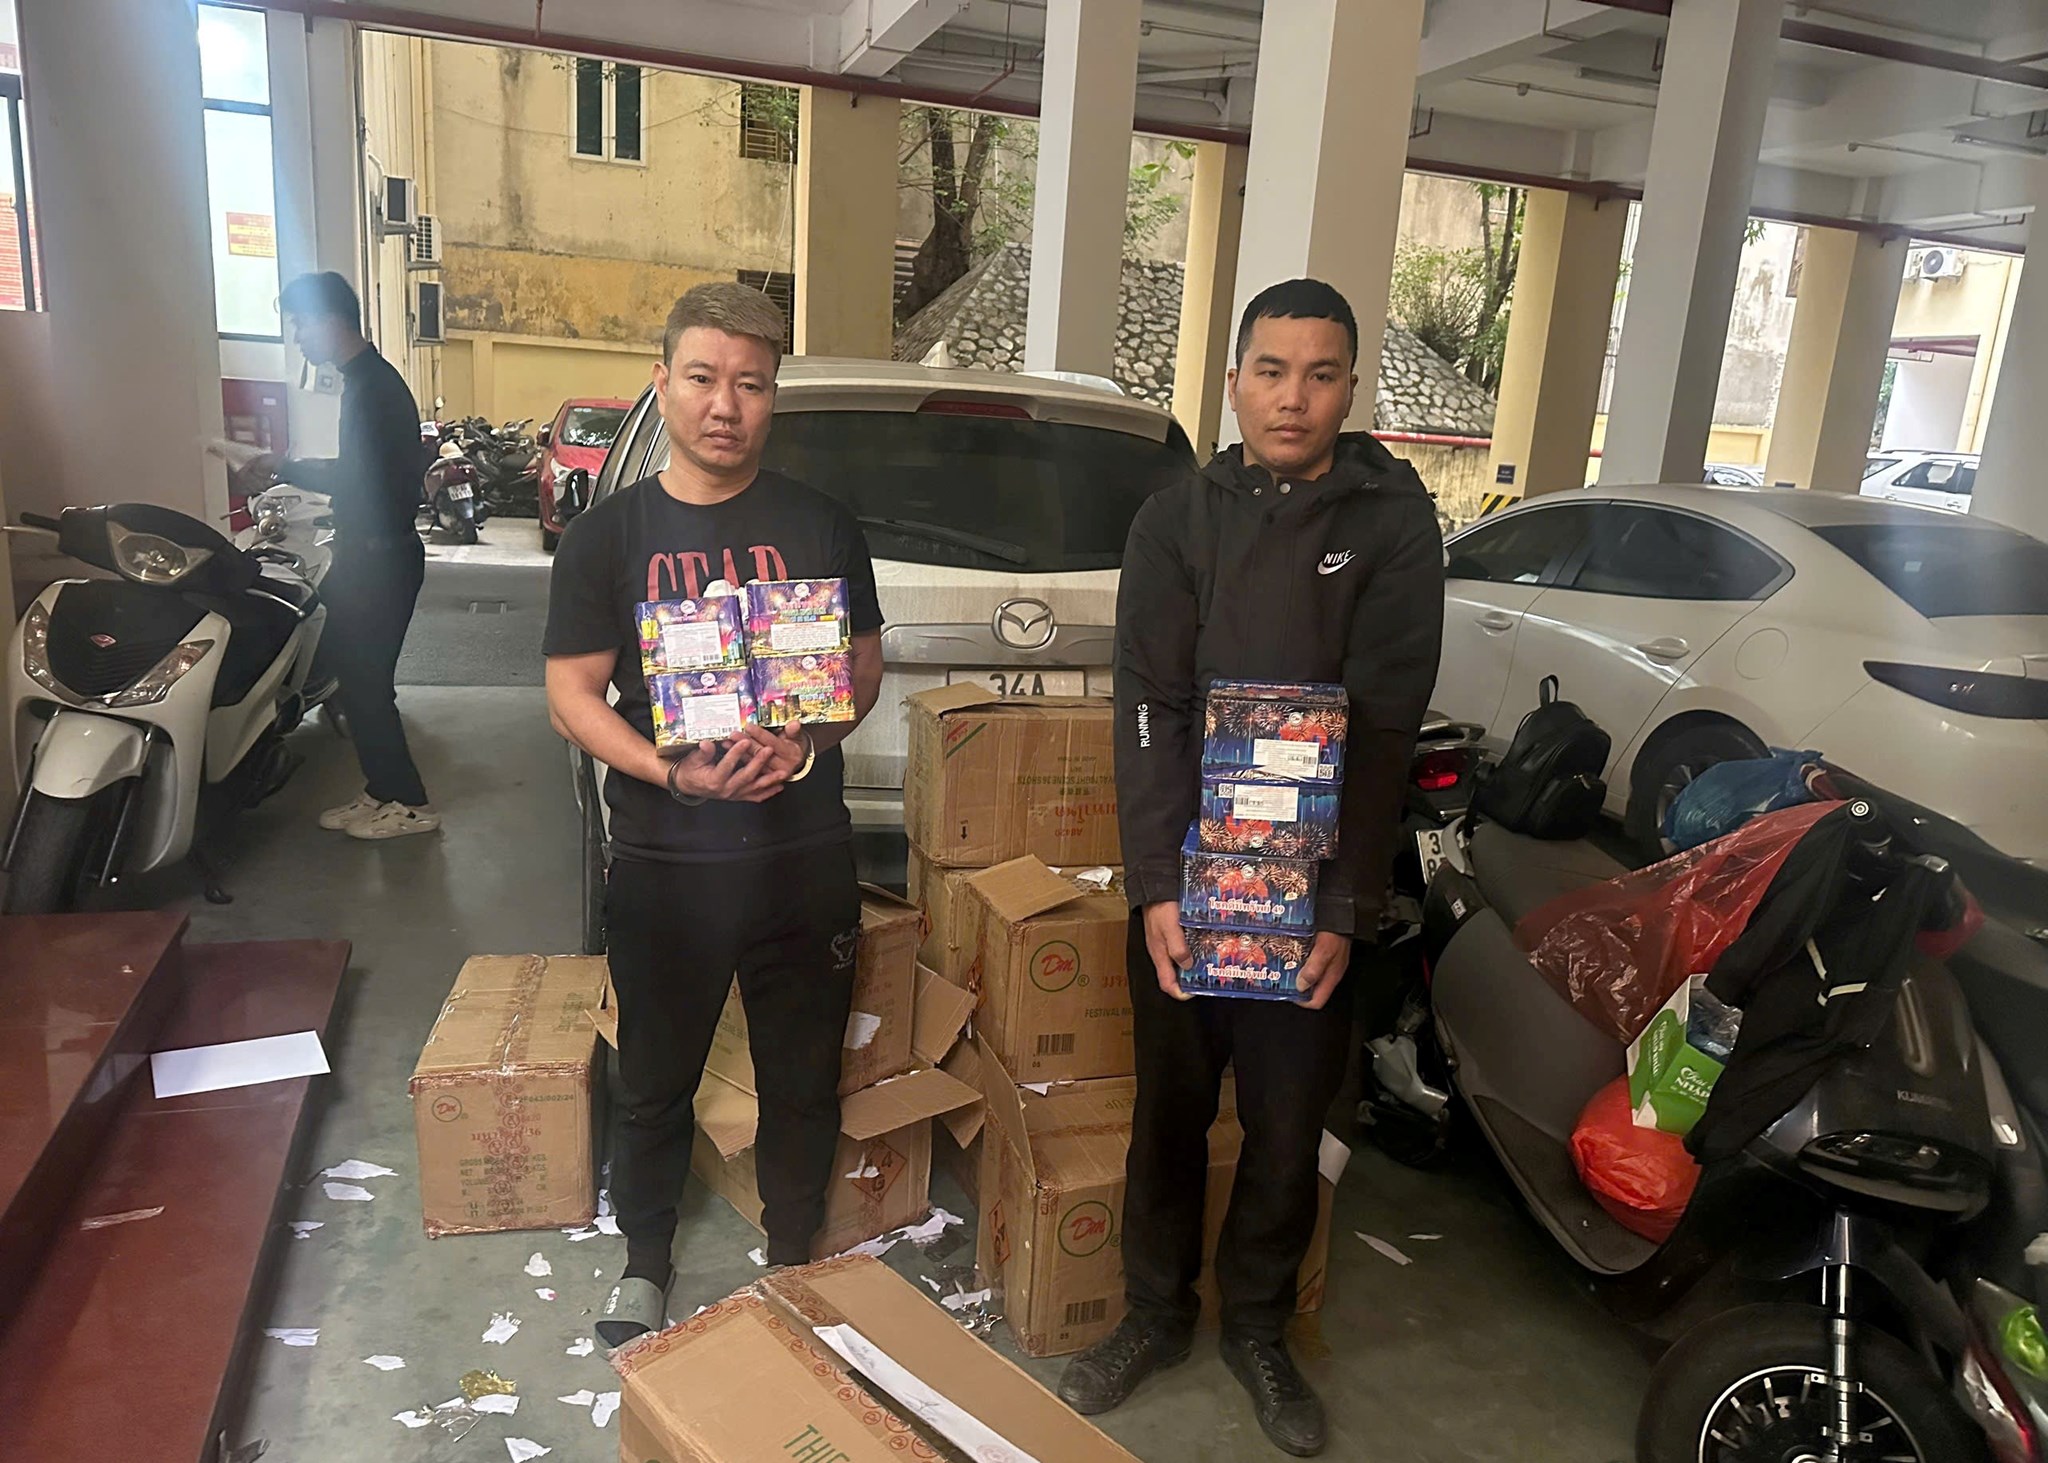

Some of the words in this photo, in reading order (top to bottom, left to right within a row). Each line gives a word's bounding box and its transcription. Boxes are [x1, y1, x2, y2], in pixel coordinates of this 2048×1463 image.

[1323, 549, 1356, 564] NIKE
[1139, 703, 1151, 749] RUNNING
[1272, 904, 1285, 915] 49
[1268, 970, 1281, 981] 49
[1084, 1008, 1120, 1018] FESTIVAL
